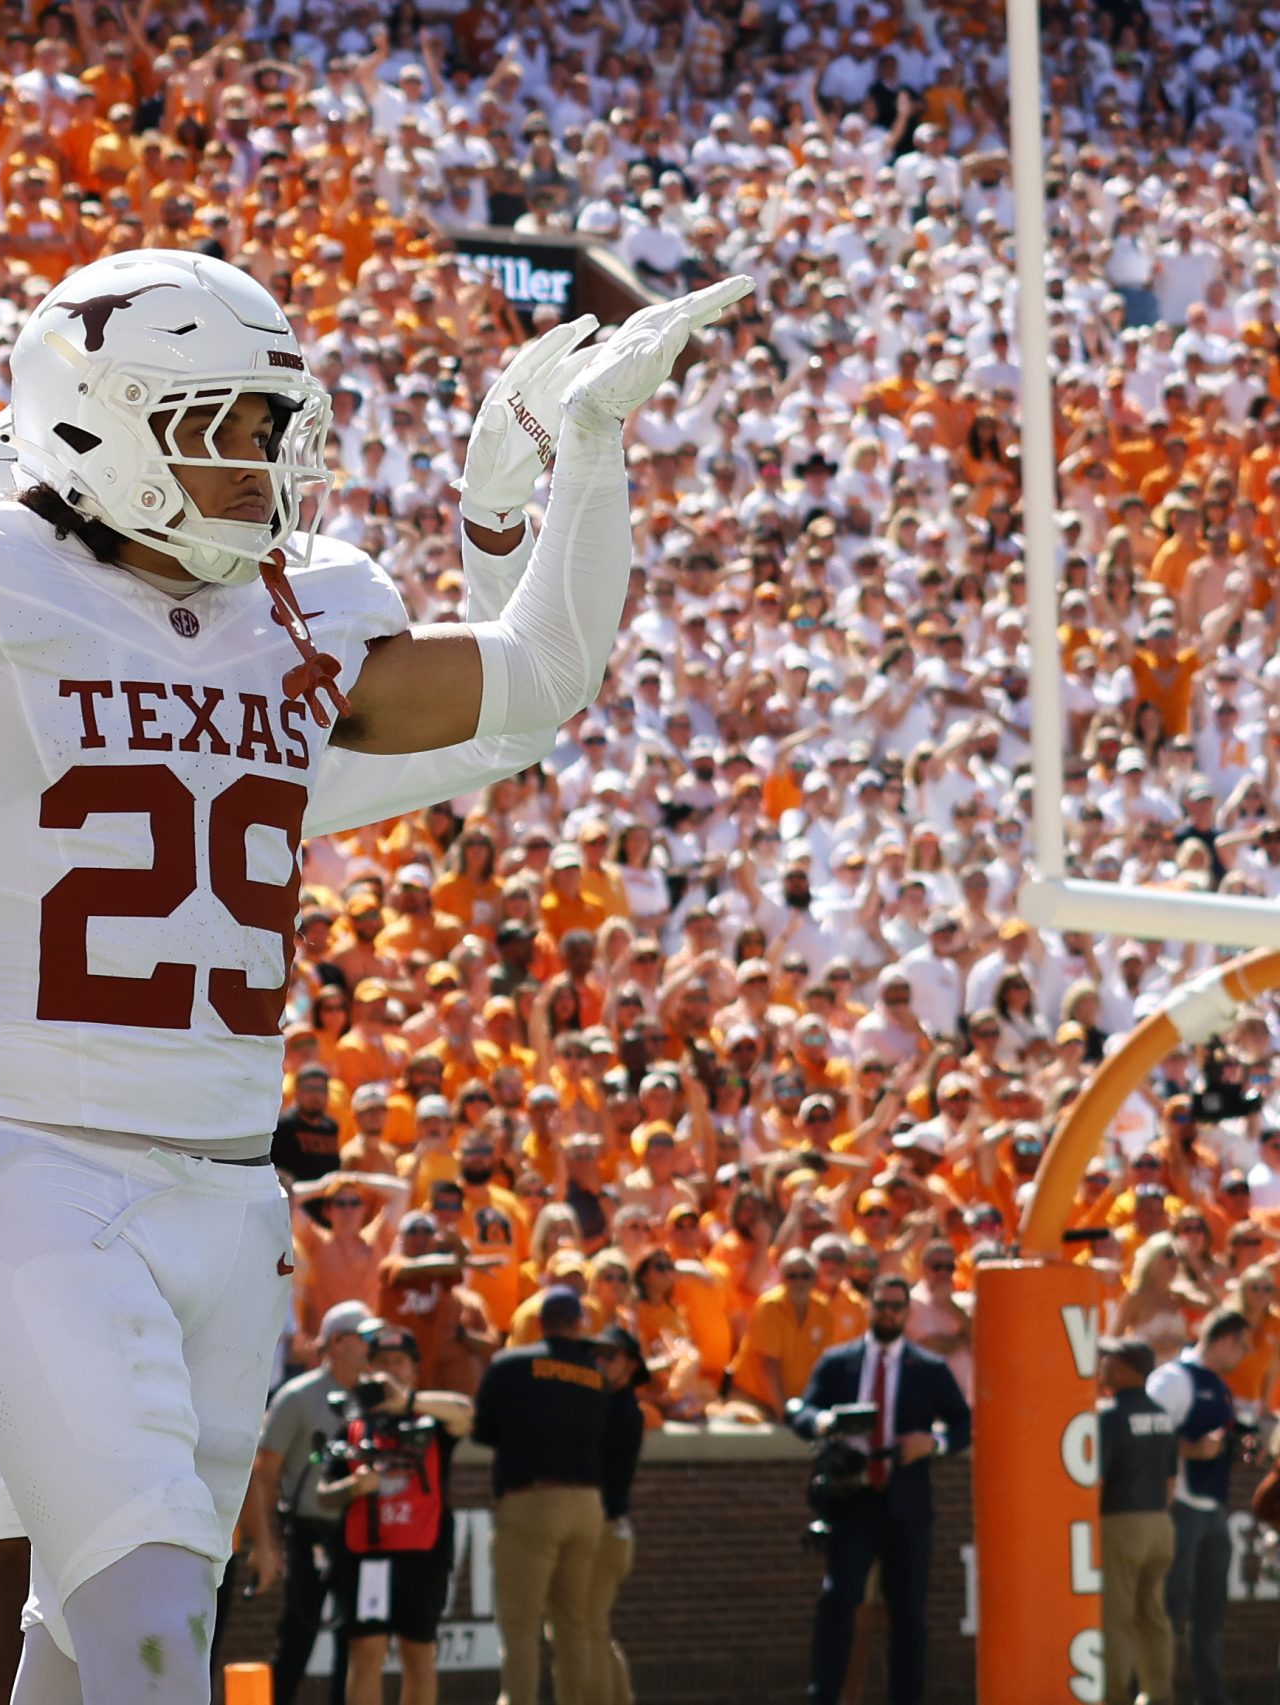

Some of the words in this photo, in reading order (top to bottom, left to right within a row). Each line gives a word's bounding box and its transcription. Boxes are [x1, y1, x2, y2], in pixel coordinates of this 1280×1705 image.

[169, 607, 200, 638] SEC
[58, 679, 310, 770] TEXAS
[36, 763, 308, 1036] 29
